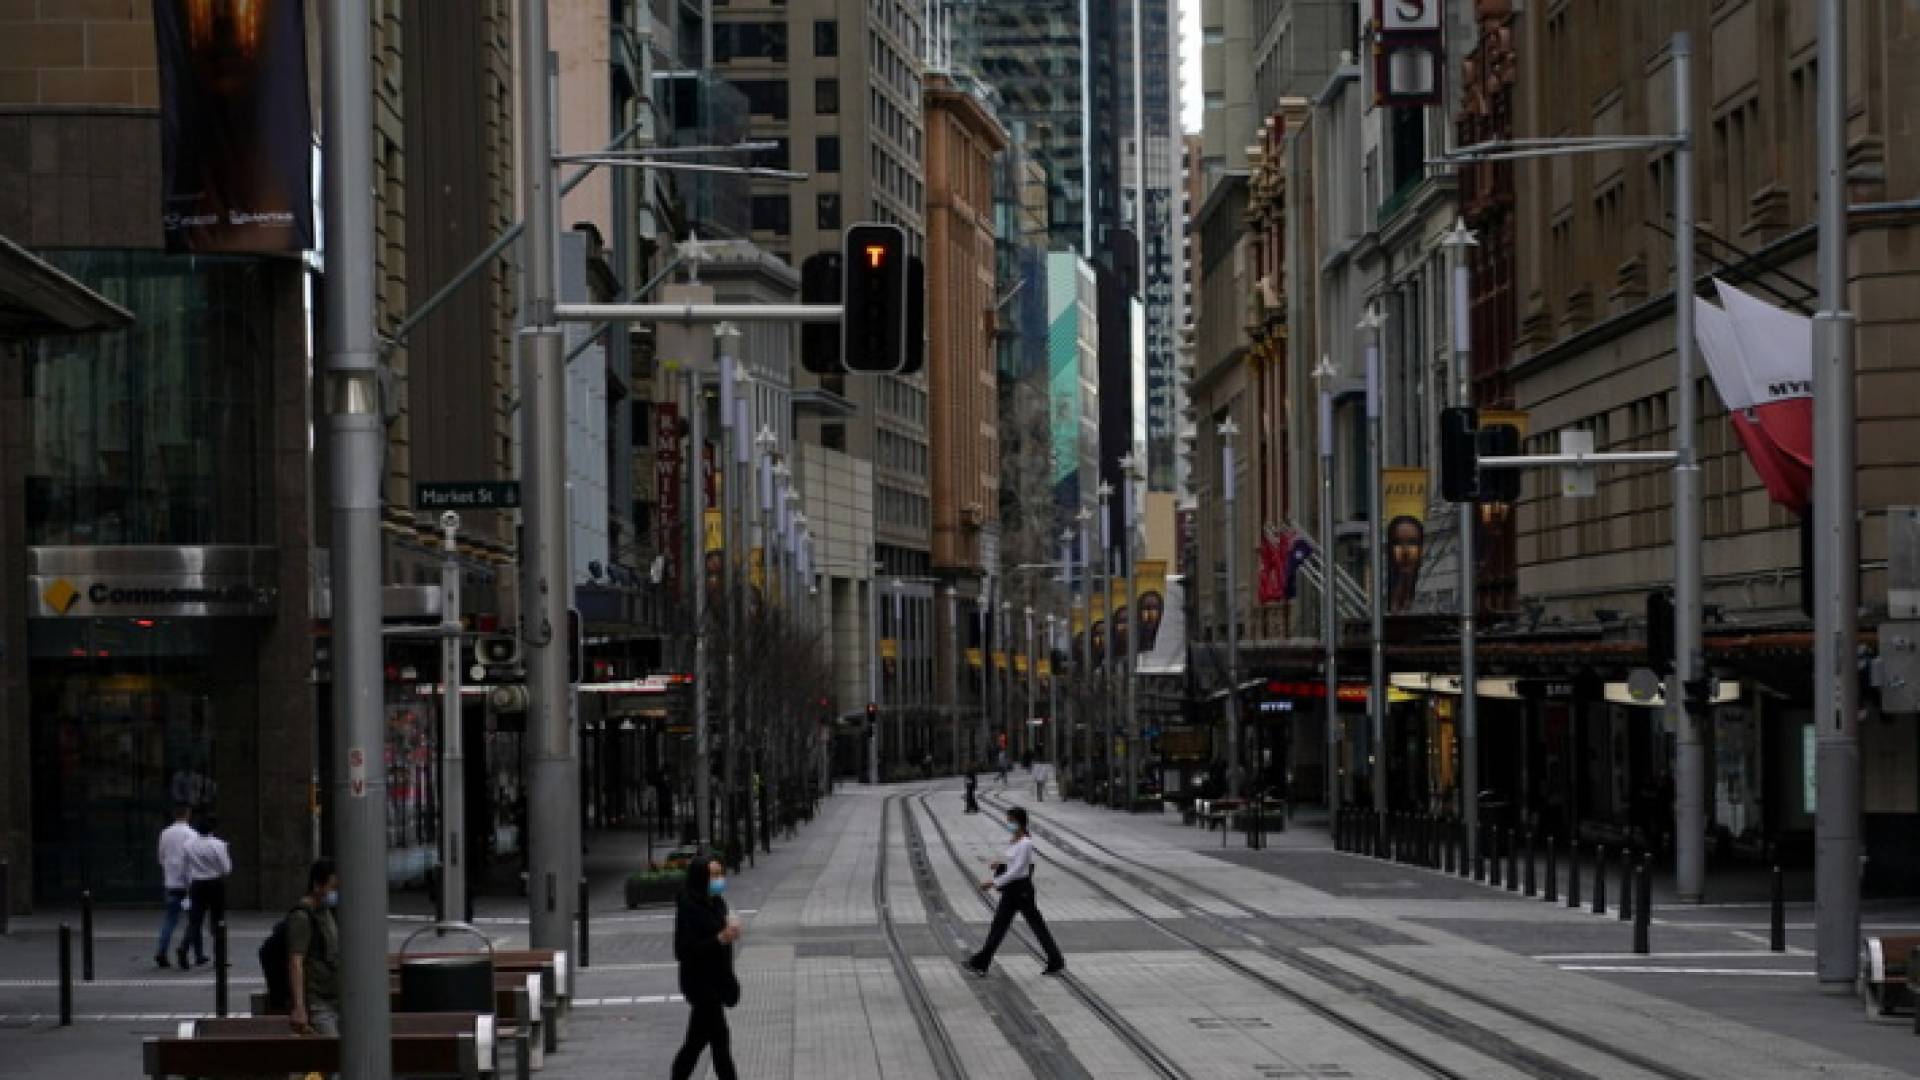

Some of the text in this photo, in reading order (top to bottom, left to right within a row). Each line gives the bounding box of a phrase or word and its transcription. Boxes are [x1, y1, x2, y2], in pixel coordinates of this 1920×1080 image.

[866, 247, 884, 269] T
[423, 487, 493, 503] Market St
